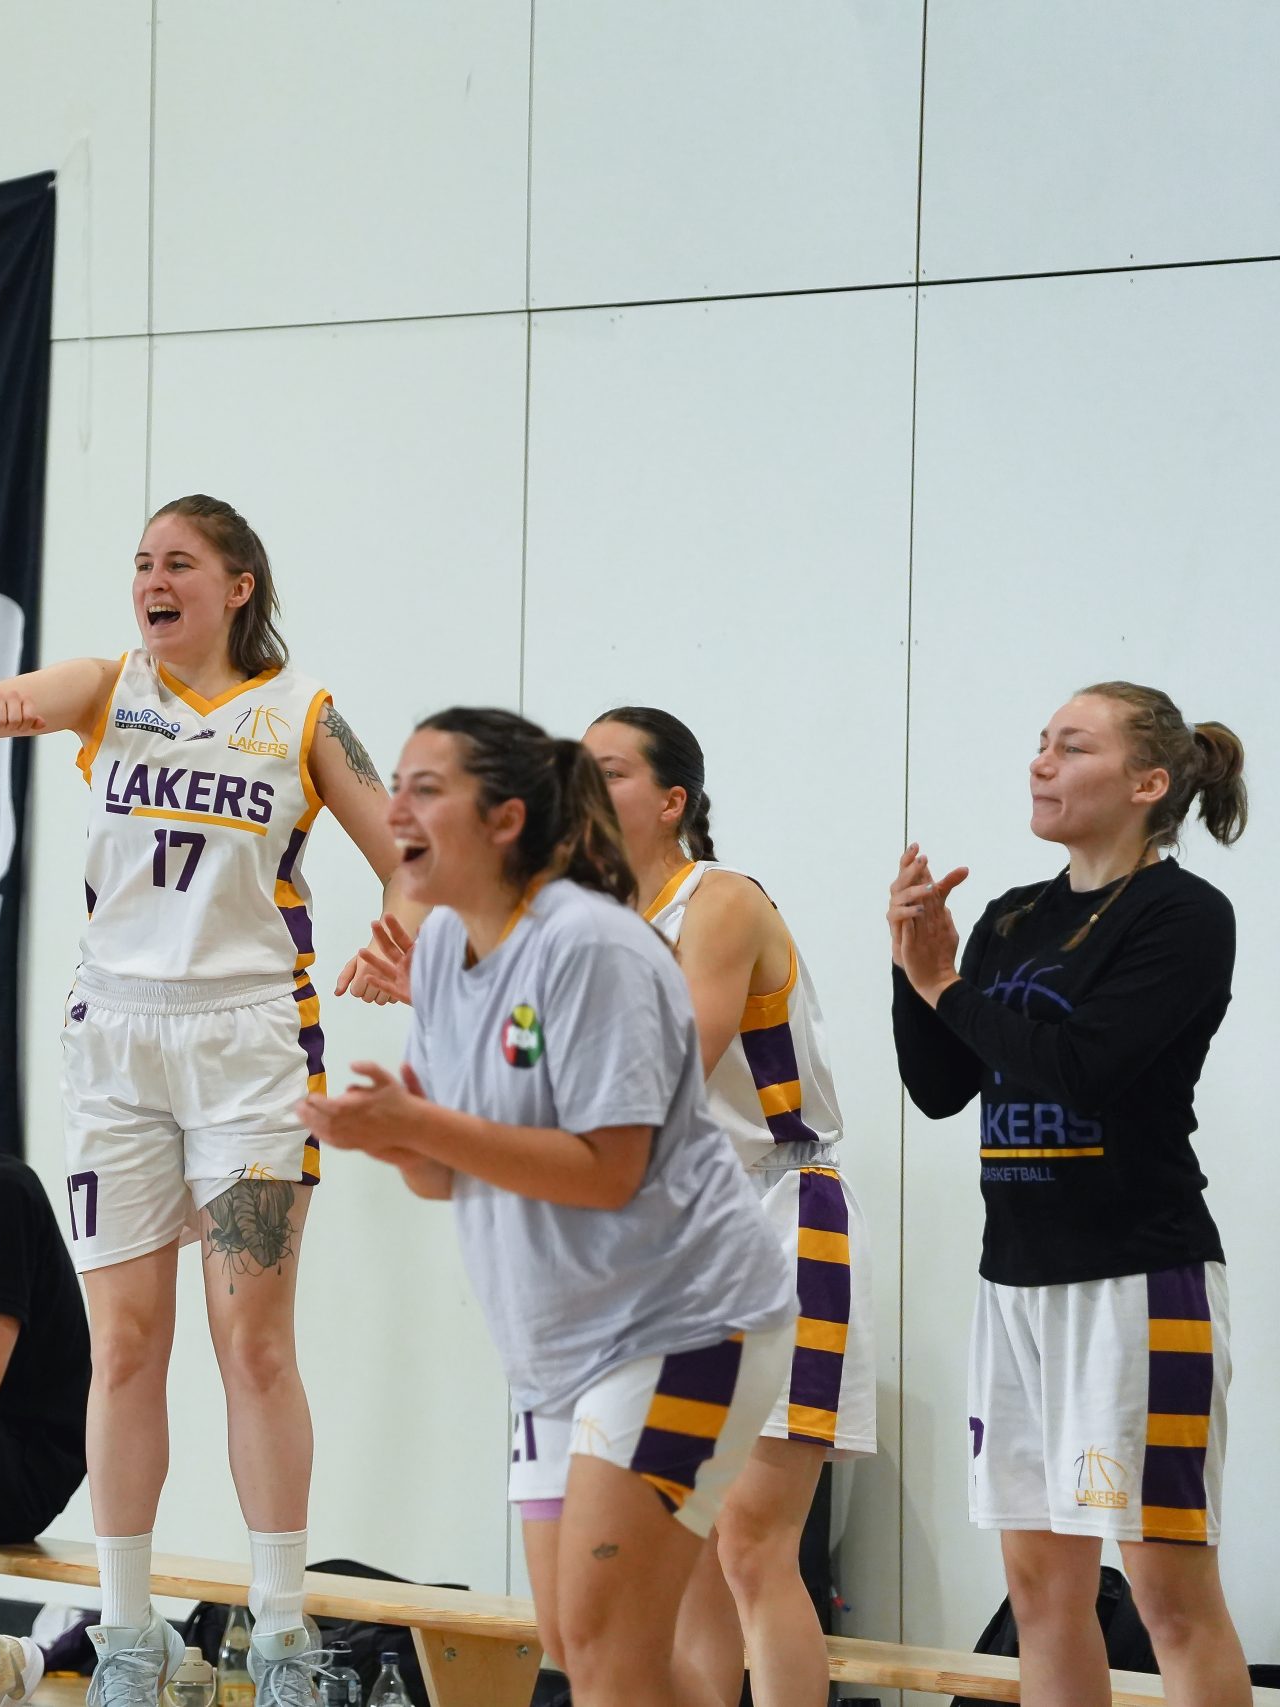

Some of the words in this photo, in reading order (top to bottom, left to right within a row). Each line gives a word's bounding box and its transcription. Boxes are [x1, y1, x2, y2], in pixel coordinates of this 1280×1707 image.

[228, 734, 289, 757] LAKERS
[106, 760, 275, 825] LAKERS
[153, 828, 207, 893] 17
